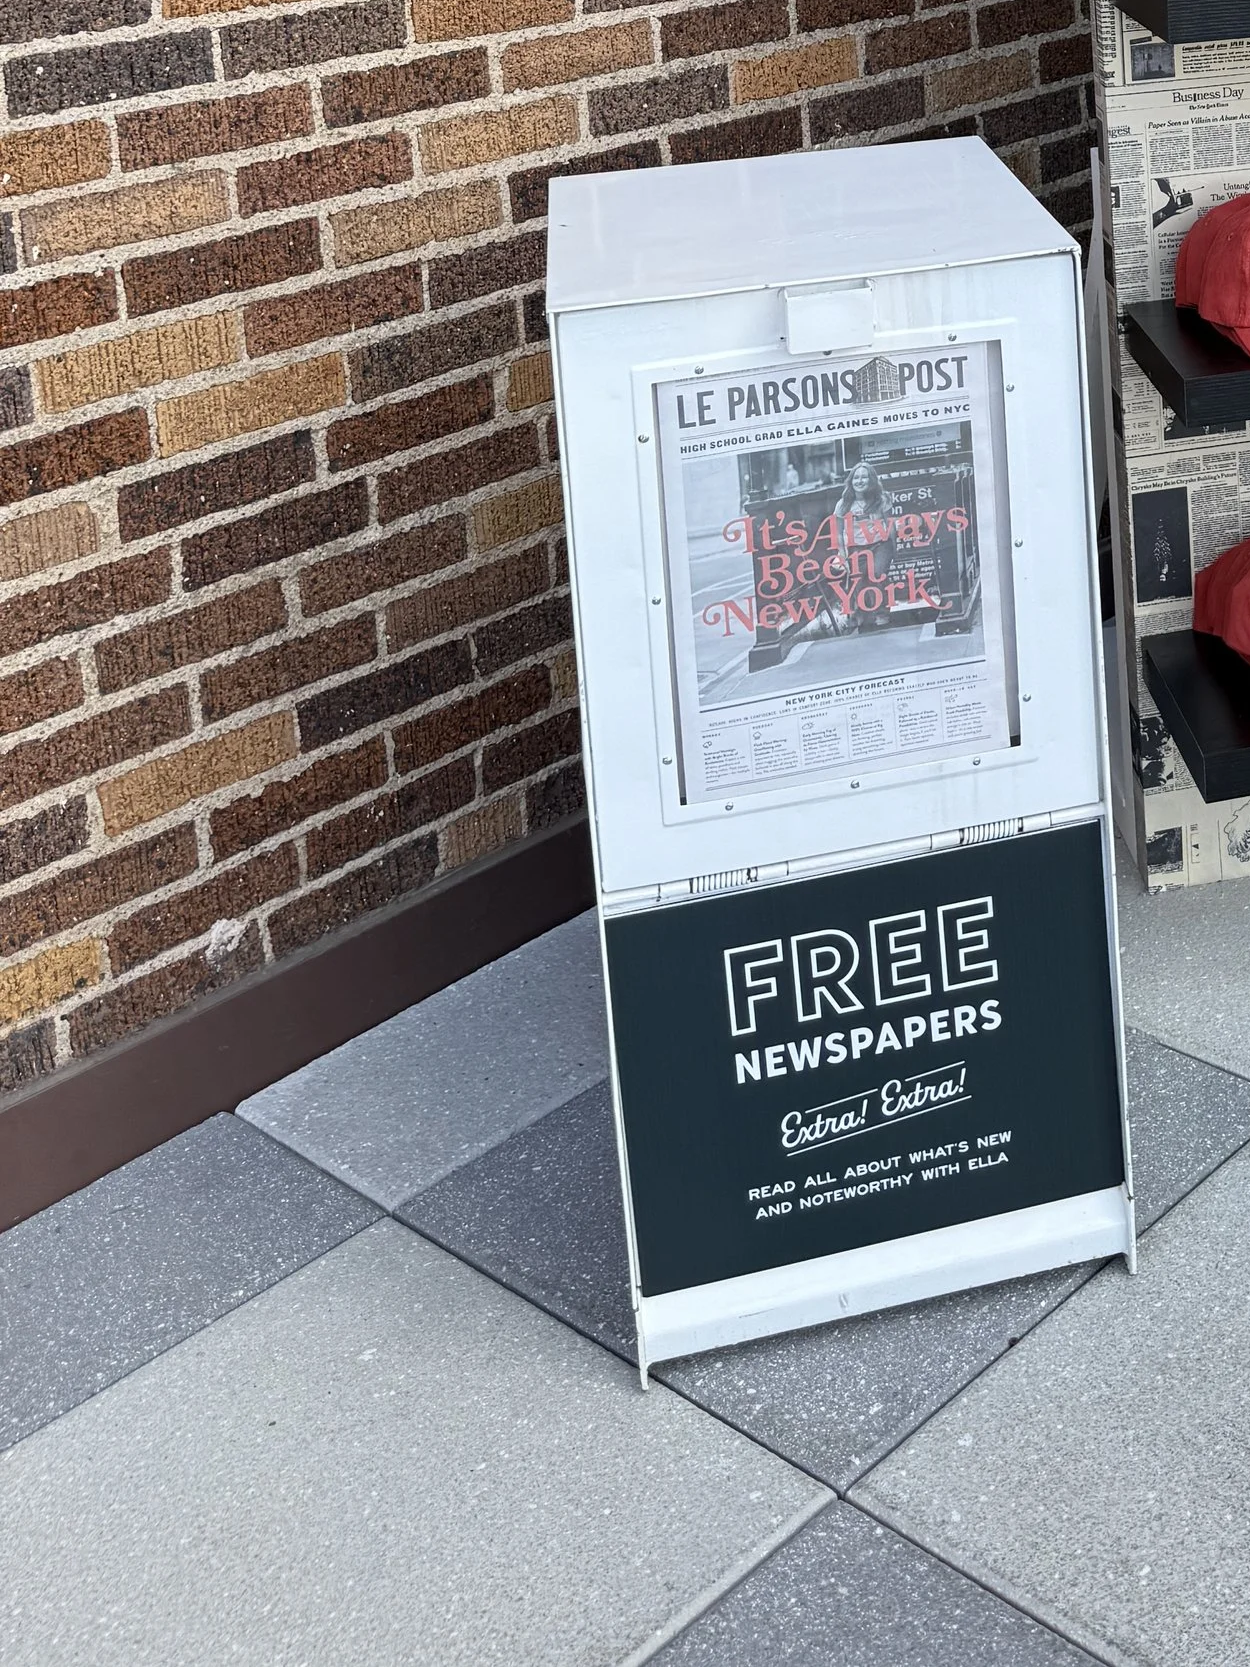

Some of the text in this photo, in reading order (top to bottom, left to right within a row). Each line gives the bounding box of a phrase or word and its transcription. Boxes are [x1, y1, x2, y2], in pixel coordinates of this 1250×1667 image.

[1148, 120, 1166, 130] Paper
[1190, 115, 1211, 124] Villain
[1219, 112, 1239, 122] Abuse
[1172, 87, 1245, 104] Business Day
[1210, 193, 1225, 202] The
[676, 355, 969, 430] LE PARSONS POST
[680, 403, 972, 455] HIGH SCHOOL GRAD ELLA GAINES MOVES TO NYC
[722, 505, 970, 558] It's Always
[702, 596, 824, 638] New
[826, 568, 953, 616] York
[757, 548, 887, 600] Been
[785, 677, 906, 707] NEW YORK CITY FORECAST
[723, 895, 1000, 1037] FREE
[733, 999, 1003, 1085] NEWSPAPERS
[780, 1066, 968, 1149] Extra! Extra!
[748, 1130, 1013, 1202] READ ALL ABOUT WHAT'S NEW
[755, 1151, 1010, 1221] AND NOTEWORTHY WITH ELLA
